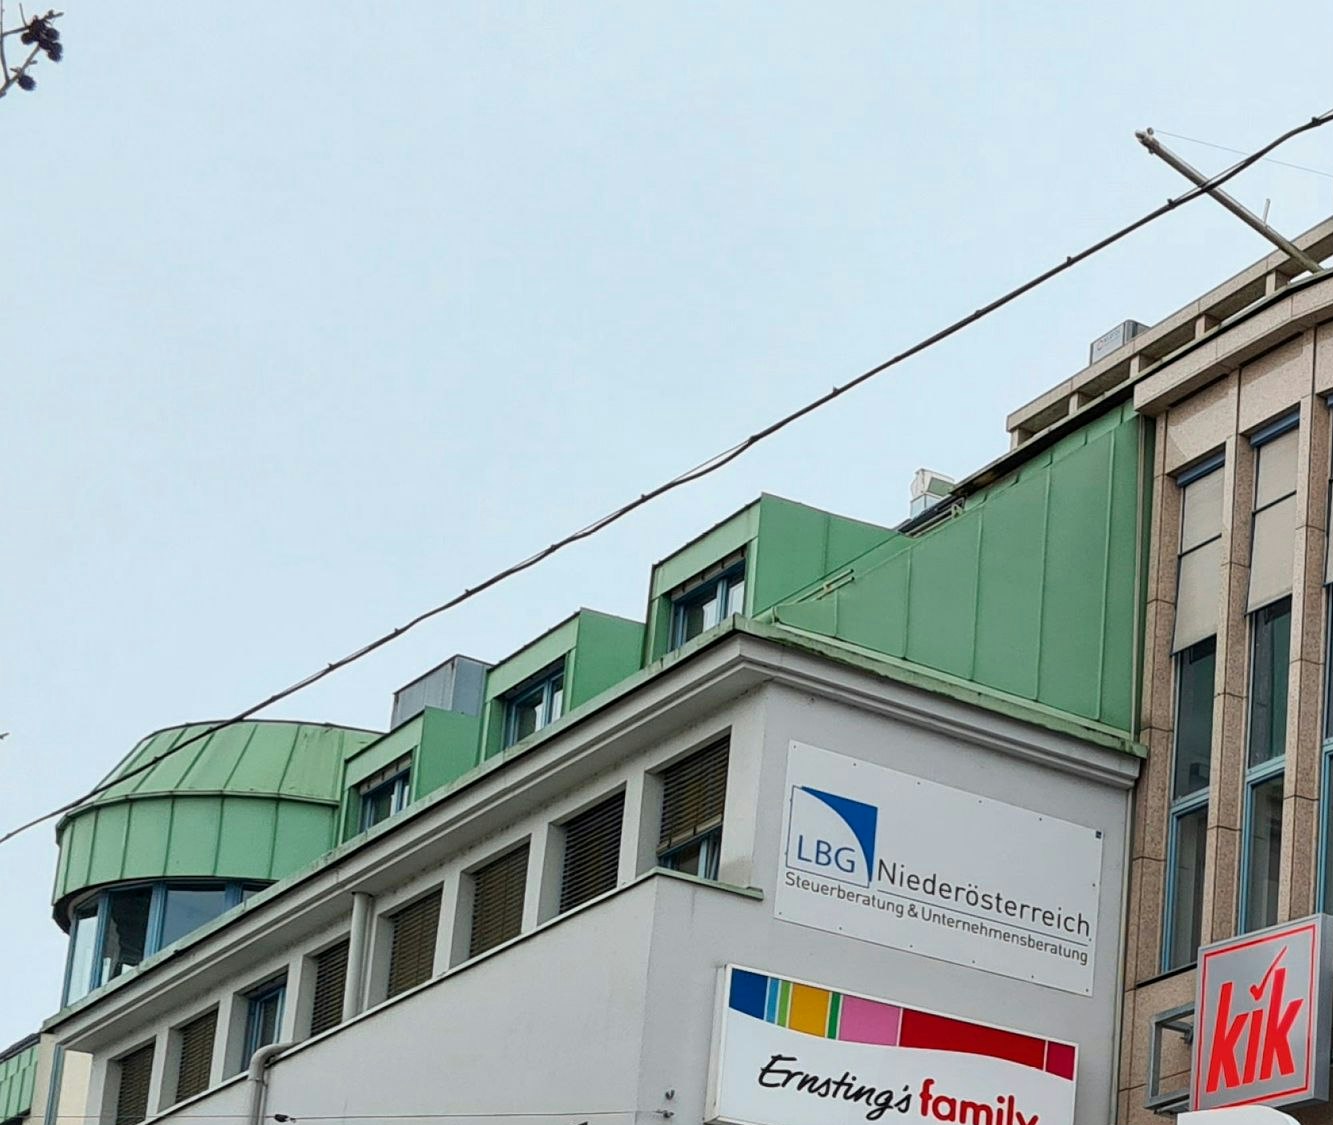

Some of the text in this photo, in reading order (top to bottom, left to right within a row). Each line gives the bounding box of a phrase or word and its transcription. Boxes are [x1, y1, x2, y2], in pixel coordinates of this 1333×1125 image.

[796, 834, 857, 874] LBG
[784, 870, 1089, 966] Steuerberatung & Unternehmensberatung
[877, 857, 1090, 938] Niederösterreich
[1204, 944, 1305, 1094] kik
[757, 1053, 912, 1122] Ernsting's
